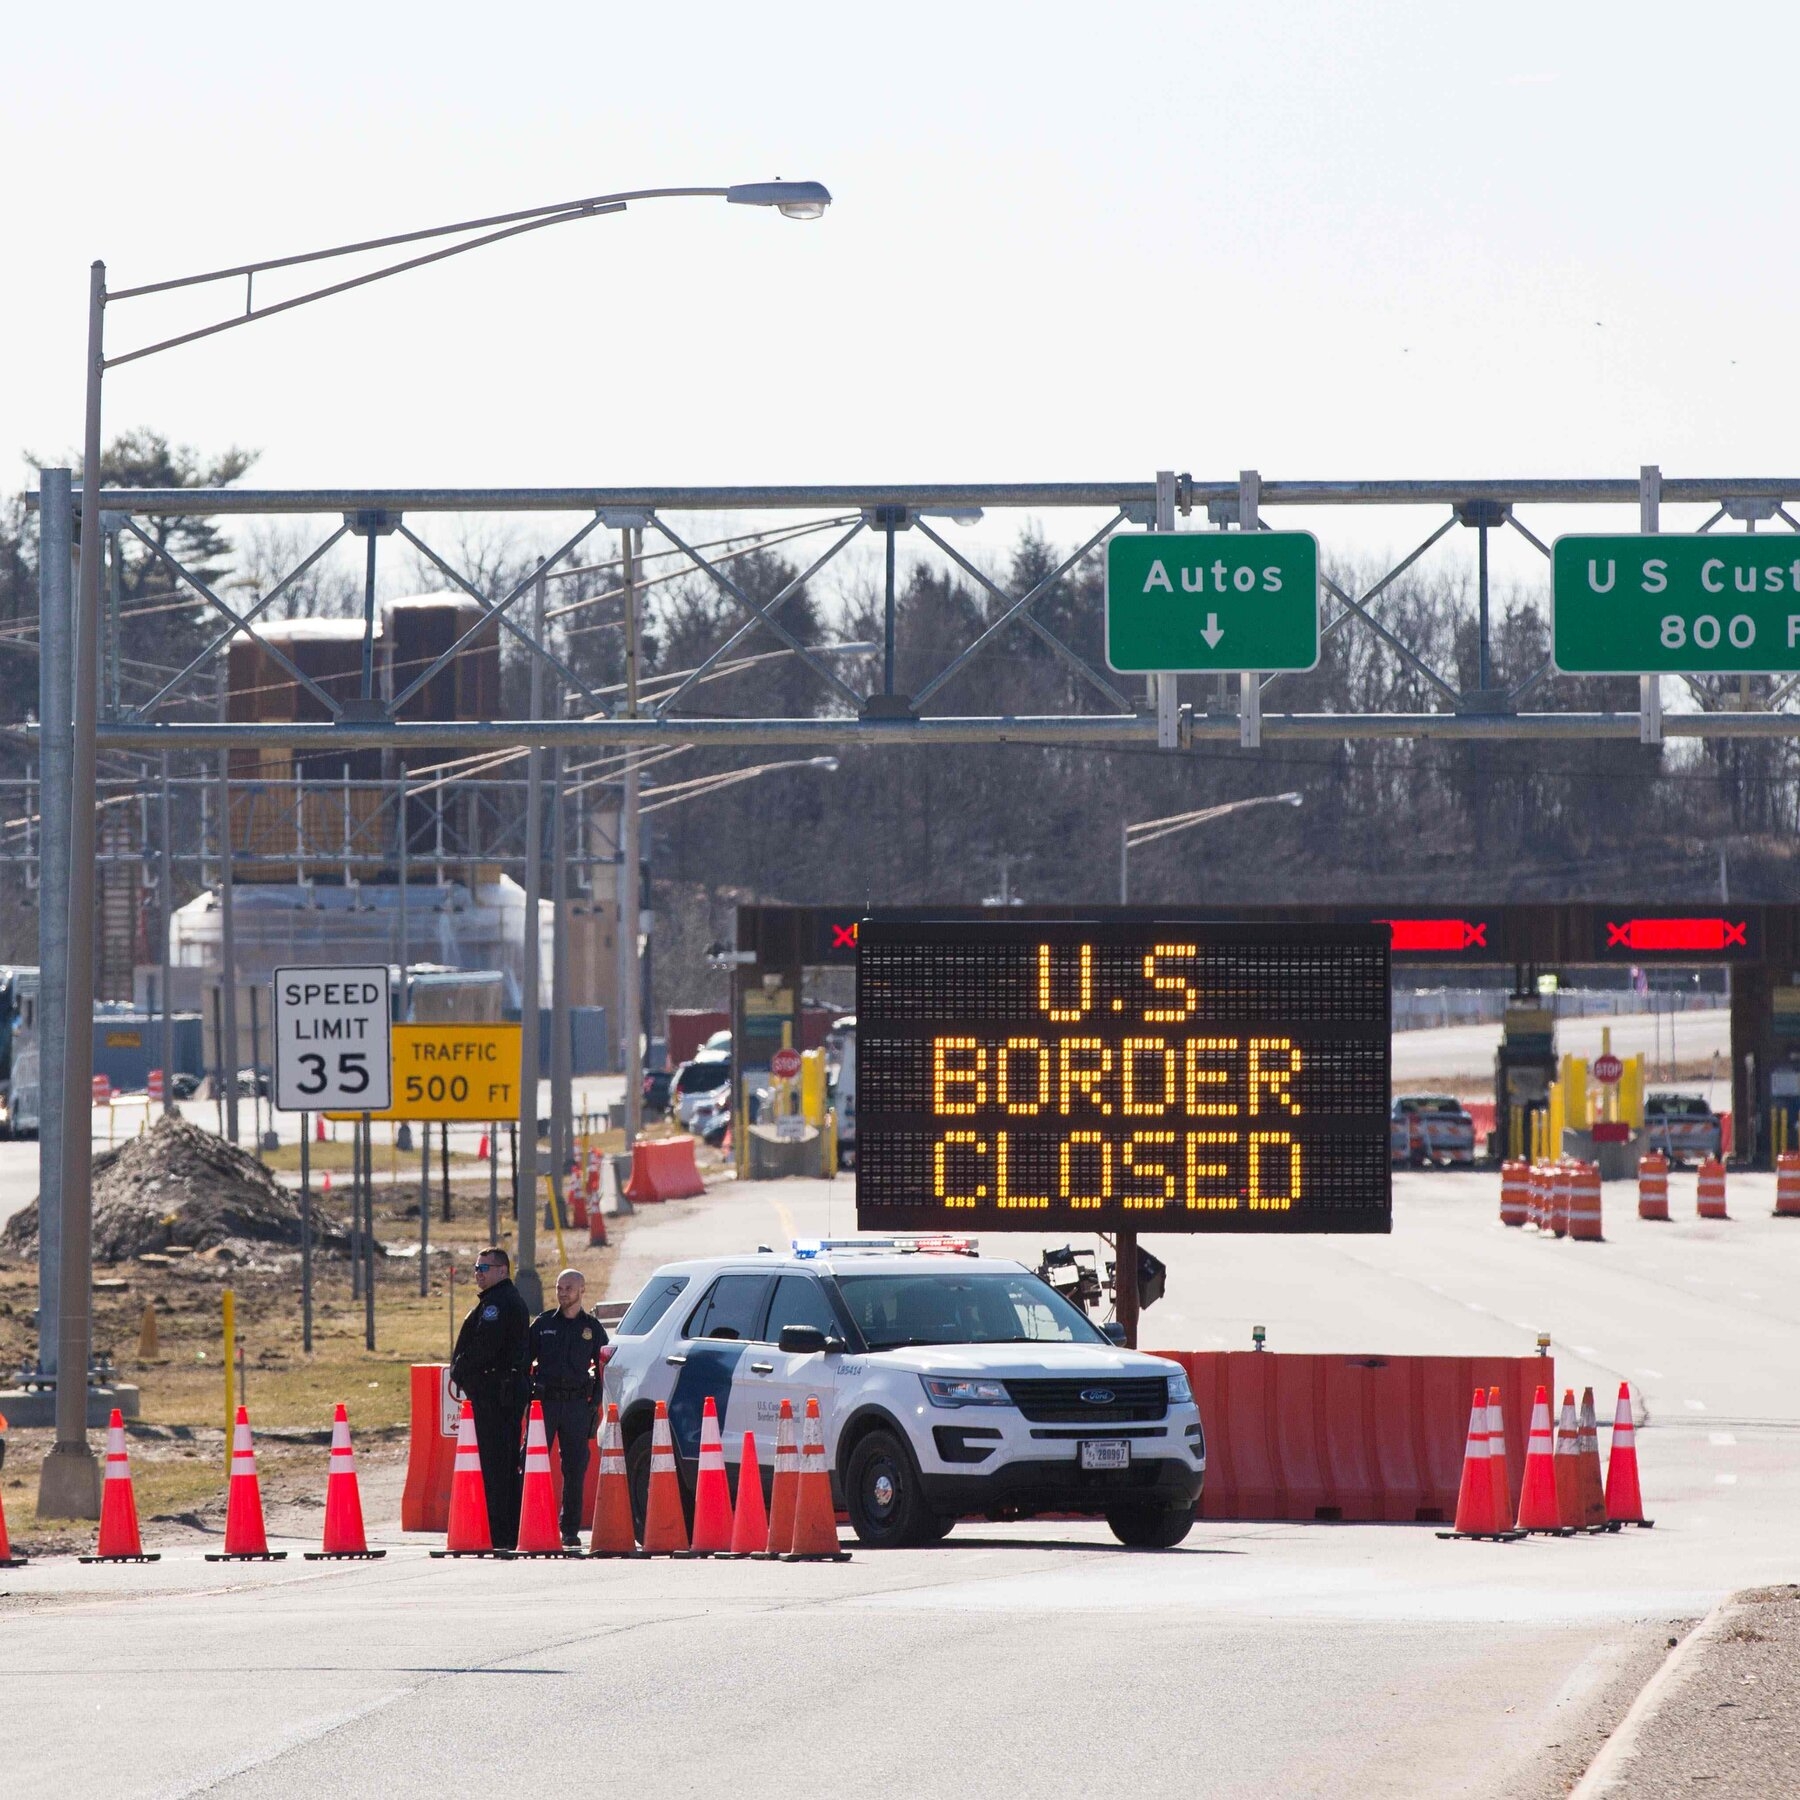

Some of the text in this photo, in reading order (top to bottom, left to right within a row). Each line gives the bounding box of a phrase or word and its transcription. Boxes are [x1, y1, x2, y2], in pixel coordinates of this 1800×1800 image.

[1142, 559, 1283, 593] Autos
[1588, 559, 1616, 593] U
[1640, 558, 1668, 593] S
[1660, 614, 1756, 649] 800
[285, 984, 379, 1006] SPEED
[1039, 944, 1196, 1021] U.S
[296, 1018, 368, 1040] LIMIT
[411, 1042, 497, 1061] TRAFFIC
[774, 1058, 800, 1069] STOP
[296, 1053, 370, 1095] 35
[934, 1038, 1301, 1115] BORDER
[1595, 1063, 1622, 1076] STOP
[406, 1075, 511, 1102] 500 FT
[934, 1131, 1301, 1209] CLOSED
[1089, 1391, 1108, 1400] Ford
